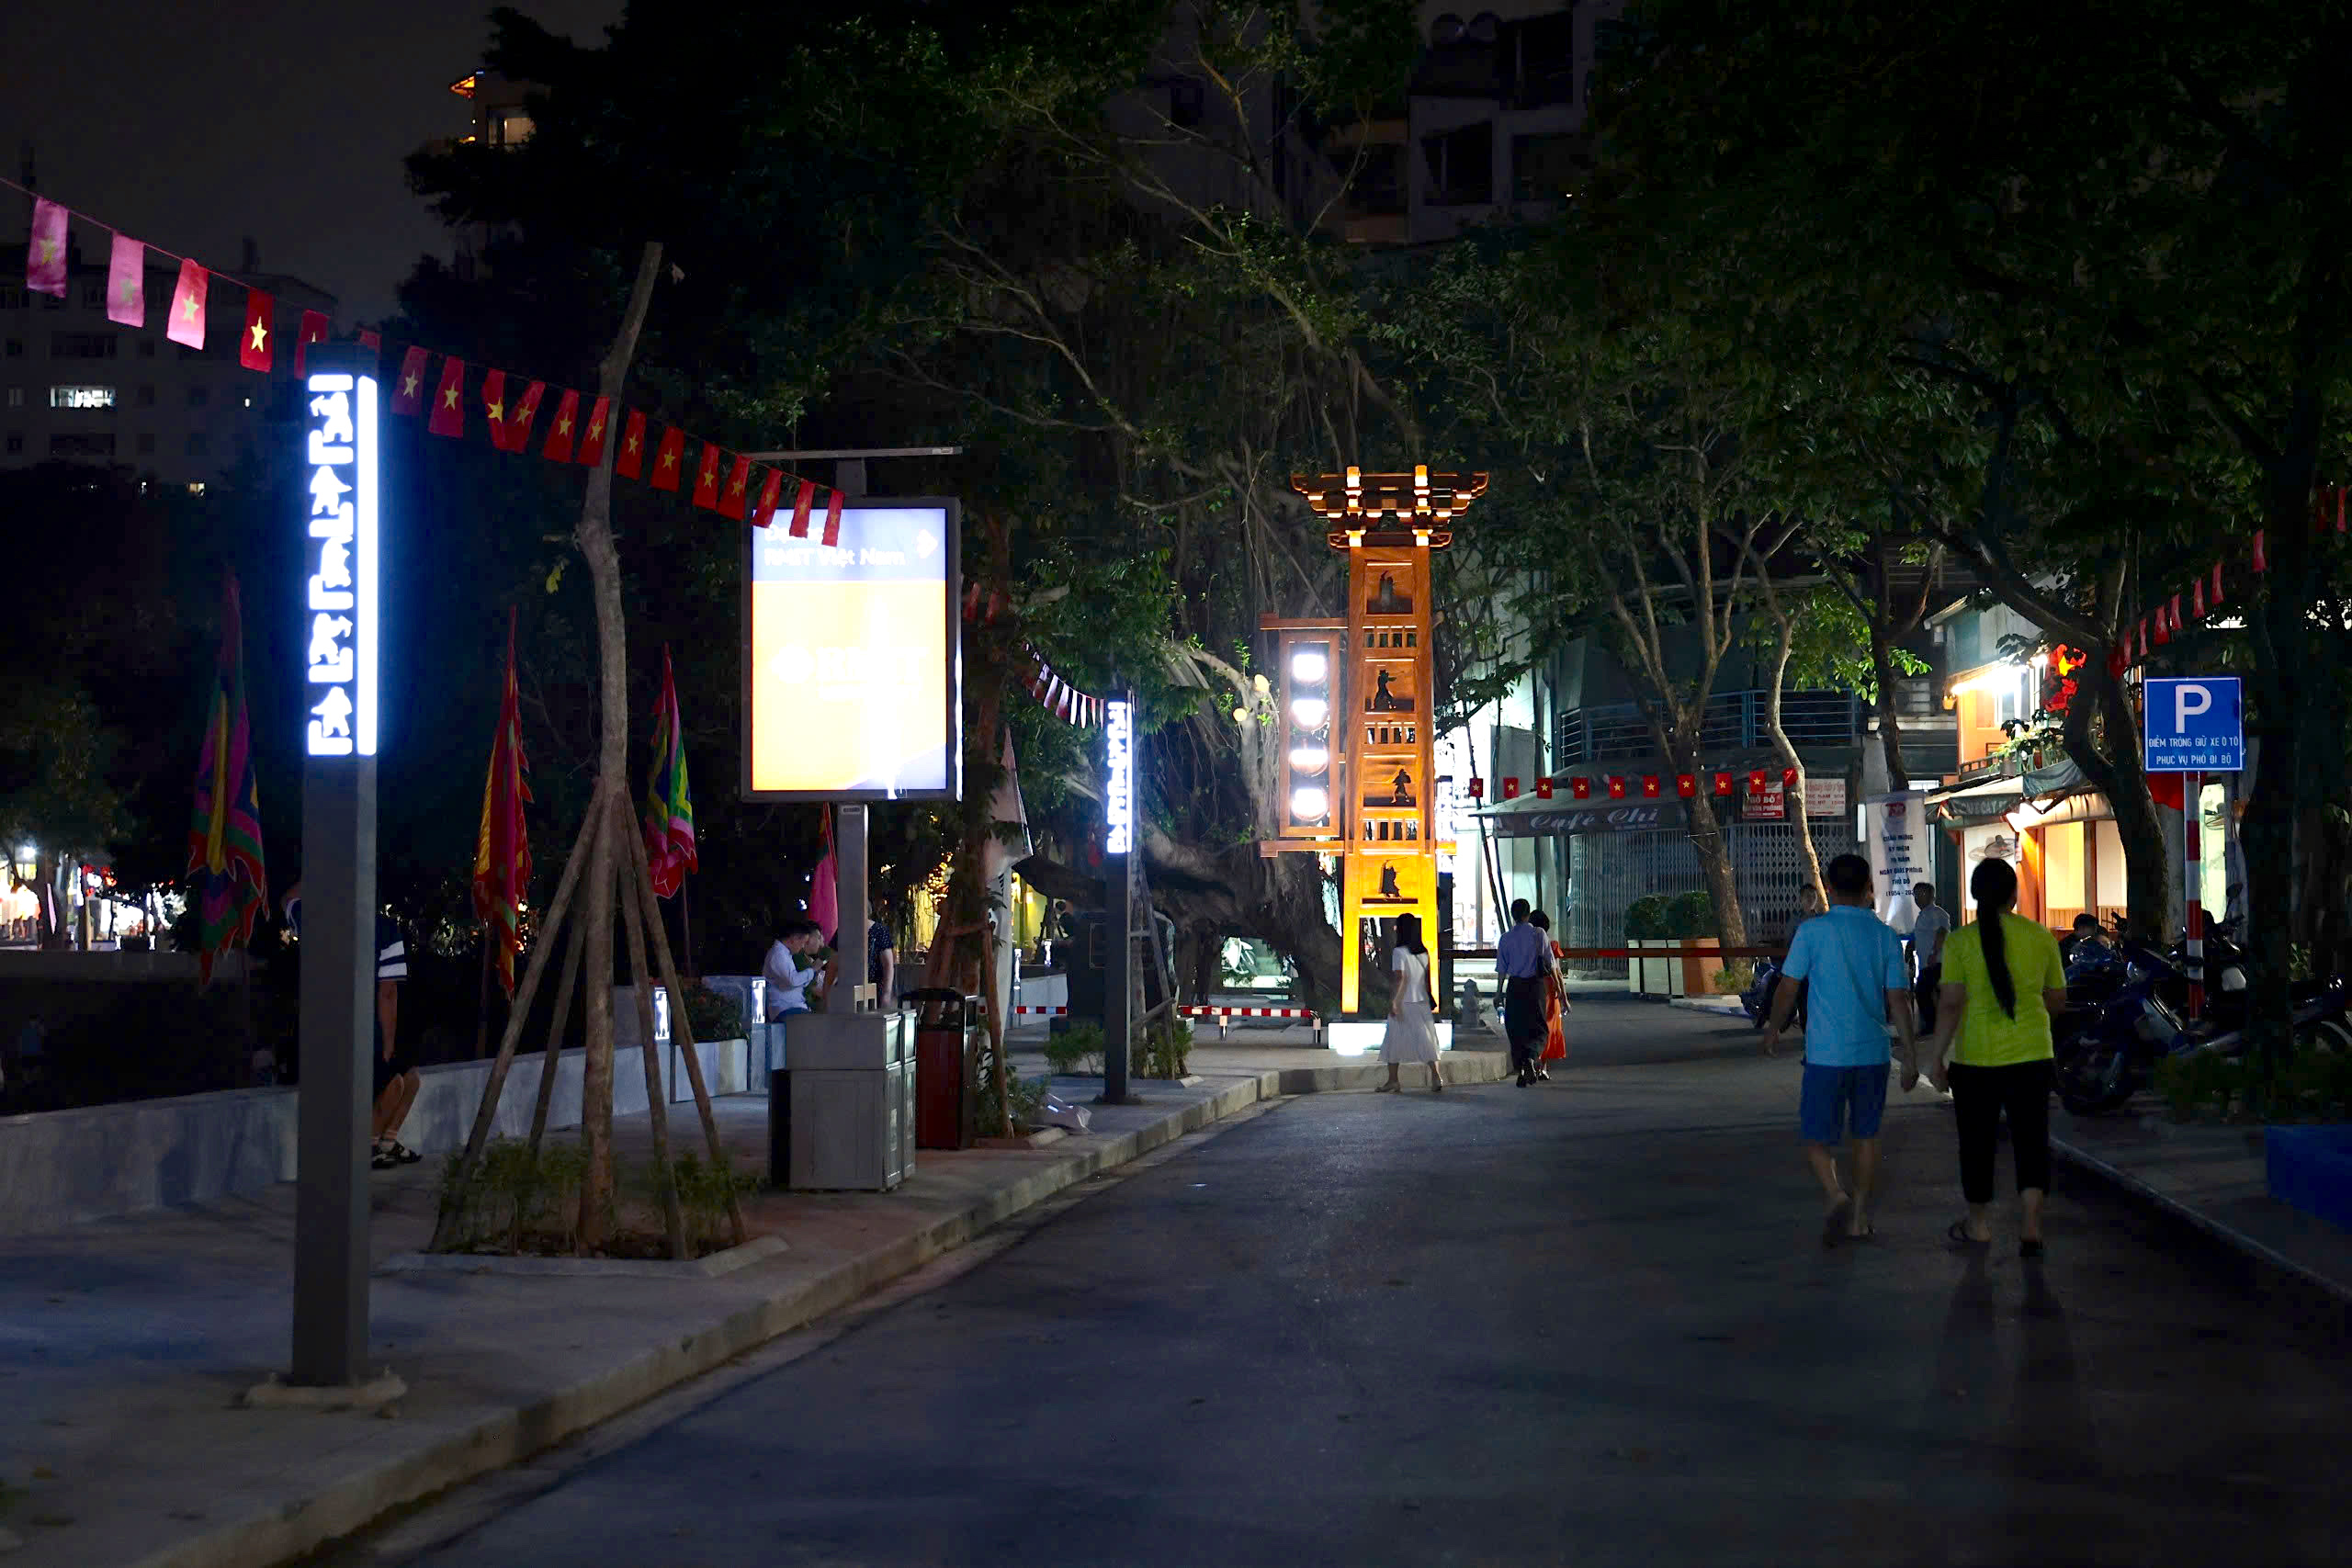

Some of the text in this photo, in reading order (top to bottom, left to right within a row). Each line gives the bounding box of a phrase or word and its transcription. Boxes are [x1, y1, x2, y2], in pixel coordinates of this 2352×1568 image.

[2175, 684, 2212, 734] P
[2210, 737, 2220, 747] XE
[2210, 754, 2217, 764] ĐI
